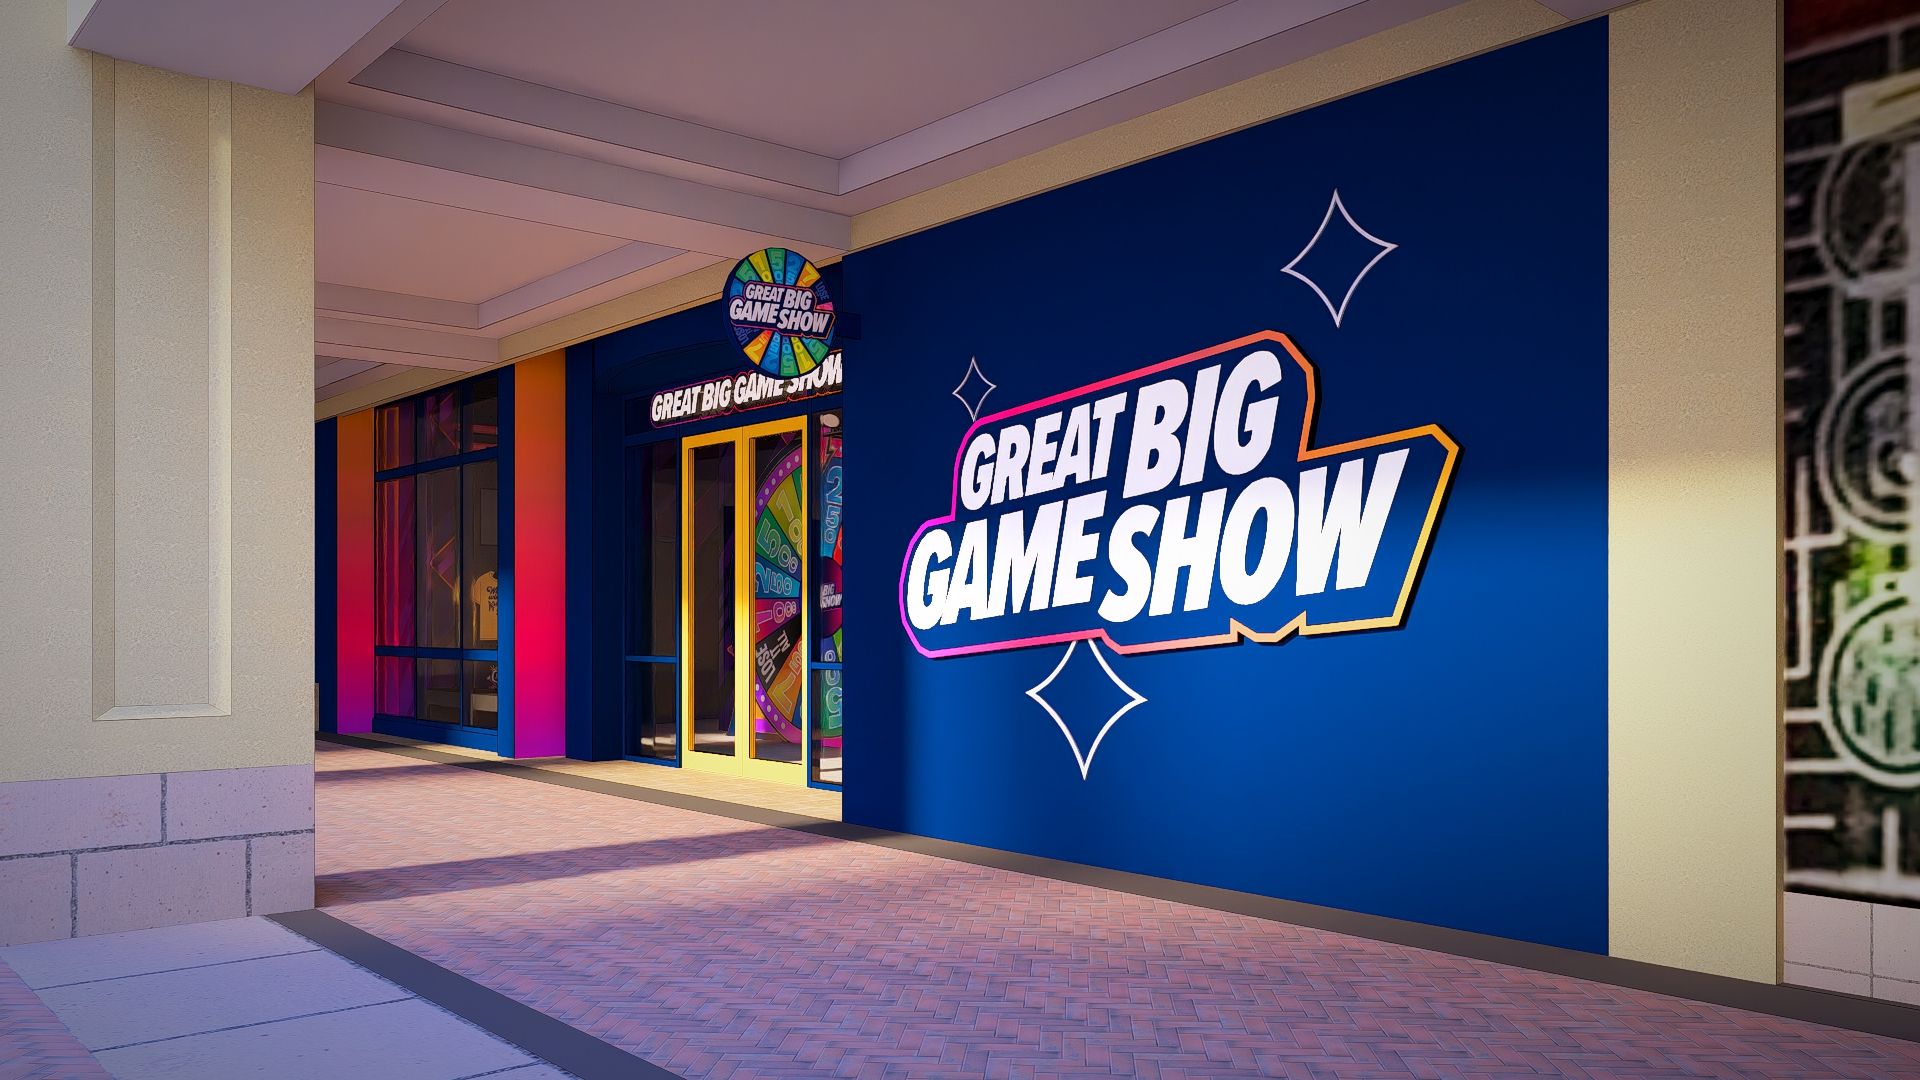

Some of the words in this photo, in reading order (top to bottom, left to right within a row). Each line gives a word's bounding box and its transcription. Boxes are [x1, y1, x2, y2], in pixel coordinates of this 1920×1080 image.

[730, 300, 781, 324] GAME
[777, 310, 829, 333] SHOW
[746, 284, 785, 302] GREAT
[783, 289, 813, 310] BIG
[652, 386, 702, 421] GREAT
[701, 379, 732, 409] BIG
[734, 373, 784, 404] GAME
[961, 392, 1128, 510] GREAT
[1122, 350, 1282, 499] BIG
[757, 518, 798, 574] 500
[907, 490, 1108, 631] GAME
[1098, 448, 1411, 623] SHOW
[777, 630, 790, 653] ALL
